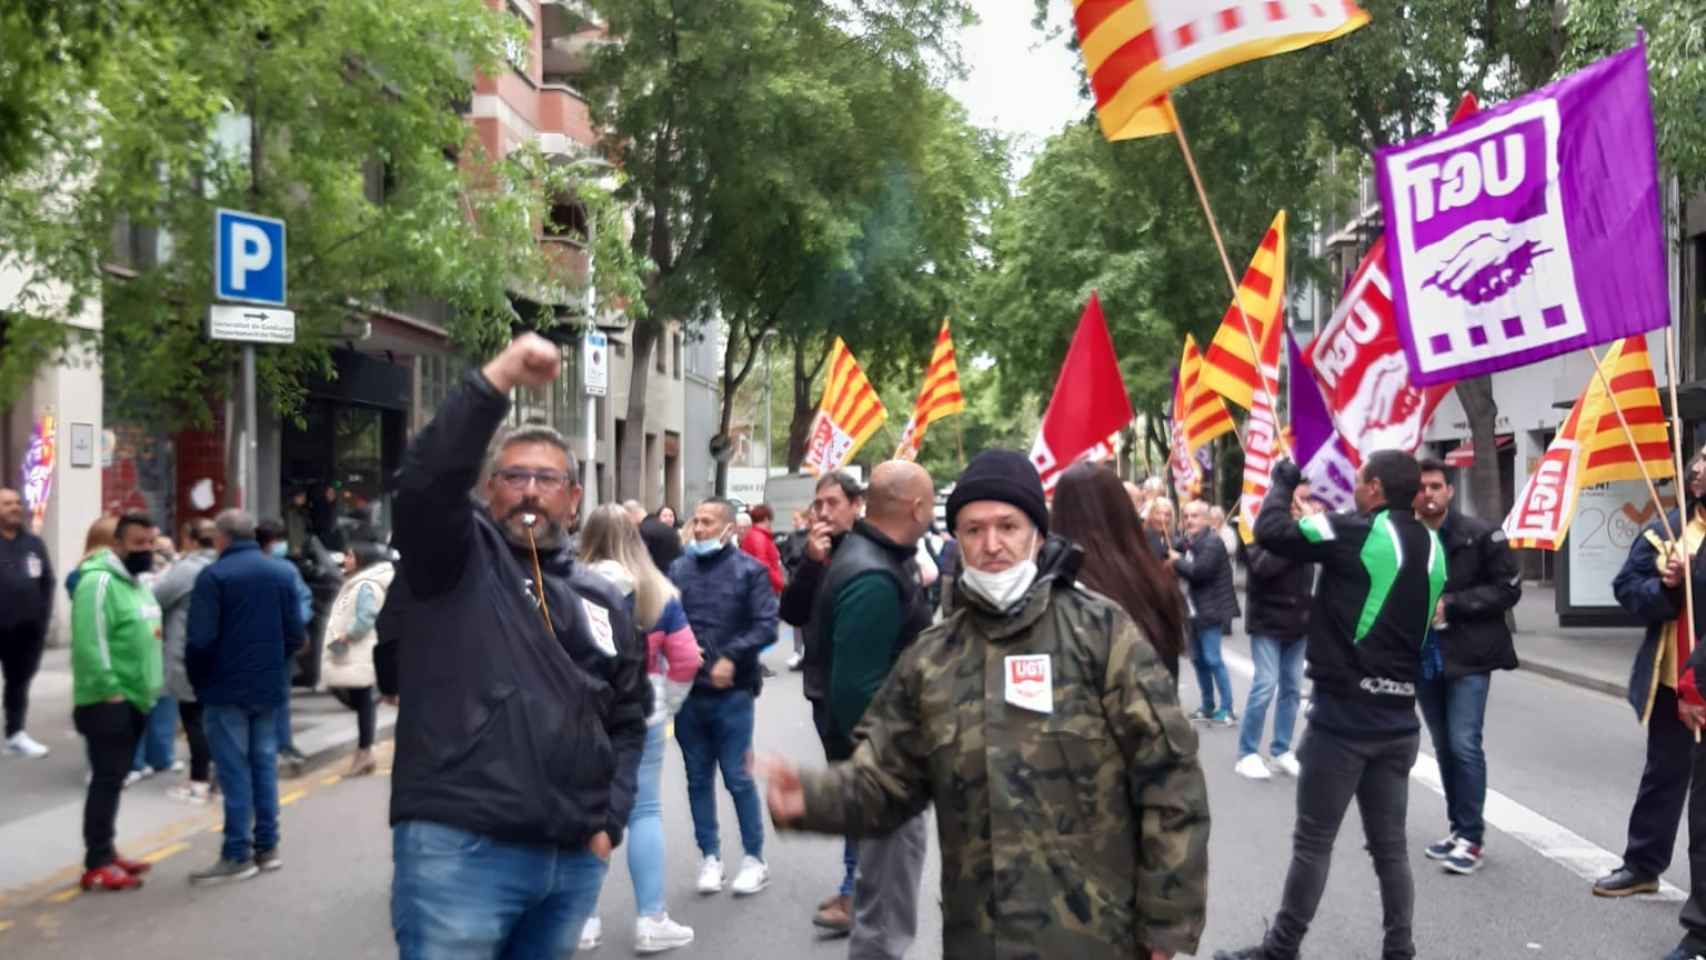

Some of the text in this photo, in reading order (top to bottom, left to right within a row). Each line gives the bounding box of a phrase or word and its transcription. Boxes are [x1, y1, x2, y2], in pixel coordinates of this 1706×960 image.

[230, 222, 273, 291] P
[1524, 459, 1564, 529] UGT
[1015, 661, 1046, 678] UGT
